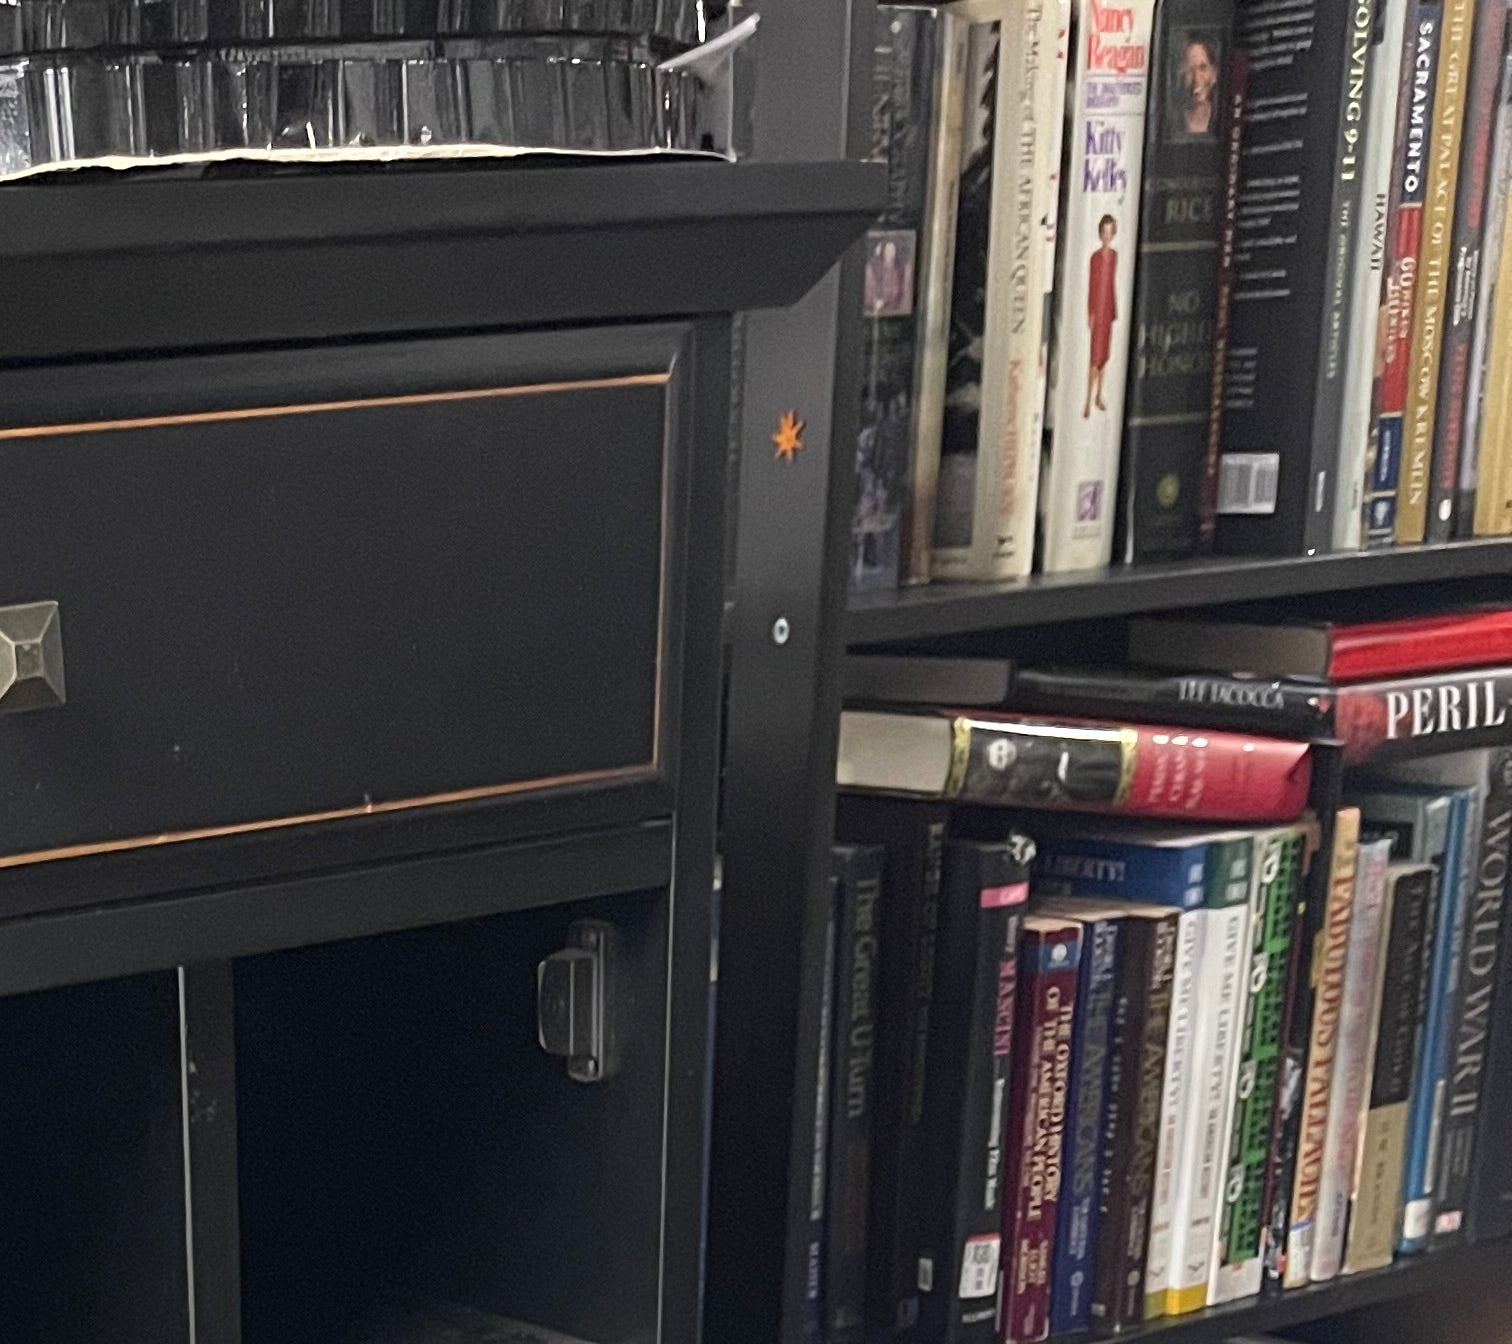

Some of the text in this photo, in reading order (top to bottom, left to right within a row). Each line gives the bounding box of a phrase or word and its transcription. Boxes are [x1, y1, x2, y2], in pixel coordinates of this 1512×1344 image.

[1087, 35, 1145, 75] Reagan
[1089, 0, 1135, 43] Nancy
[1450, 4, 1465, 41] THE
[1085, 120, 1123, 156] Kitty
[1404, 20, 1436, 193] SACRAMENTO
[1341, 128, 1359, 181] 9-11
[1433, 132, 1453, 214] PALACE
[1371, 193, 1386, 271] HAWAII
[1427, 257, 1441, 297] THE
[1419, 306, 1436, 400] MOSCOW
[1408, 404, 1429, 505] KREMLIN
[1386, 678, 1507, 741] PERIL
[1450, 807, 1512, 1116] WORLD WAR II
[1296, 874, 1356, 1221] FABULOUS FALLACIES
